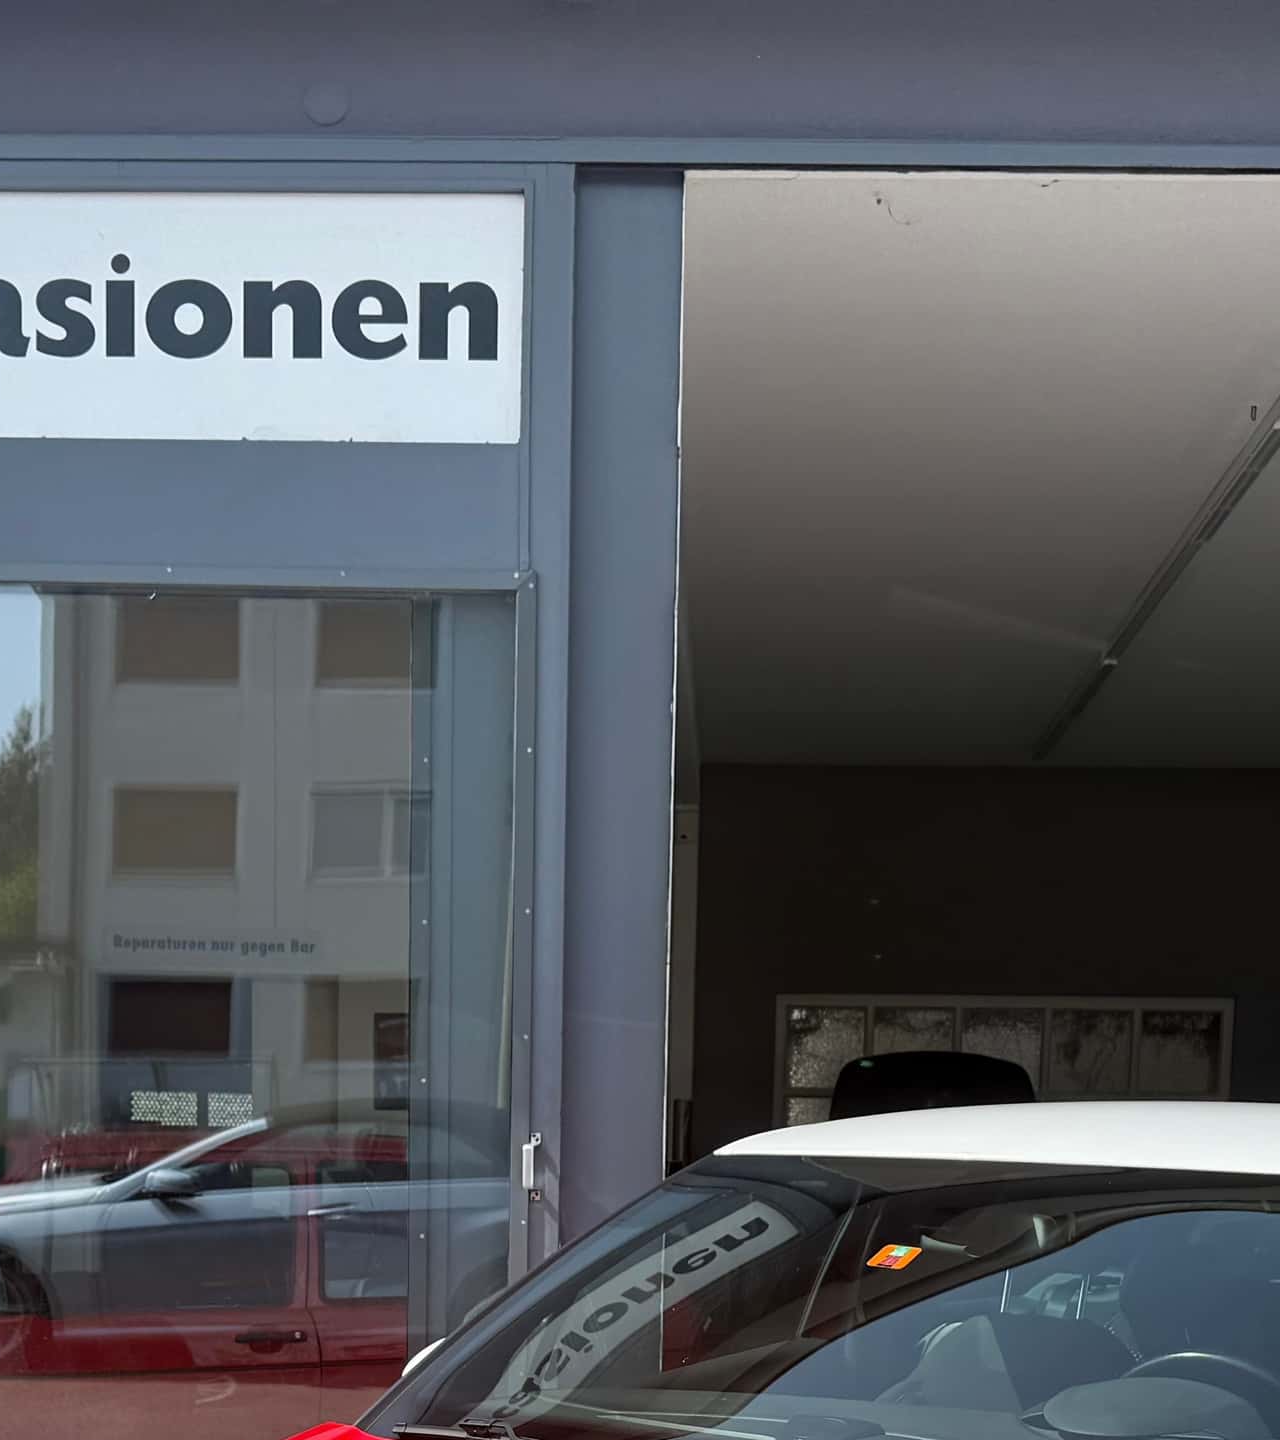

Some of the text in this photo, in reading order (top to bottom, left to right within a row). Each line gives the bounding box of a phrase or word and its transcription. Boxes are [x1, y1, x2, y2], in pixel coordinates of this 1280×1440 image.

[112, 933, 317, 957] Reparaturen nur gegen Bar
